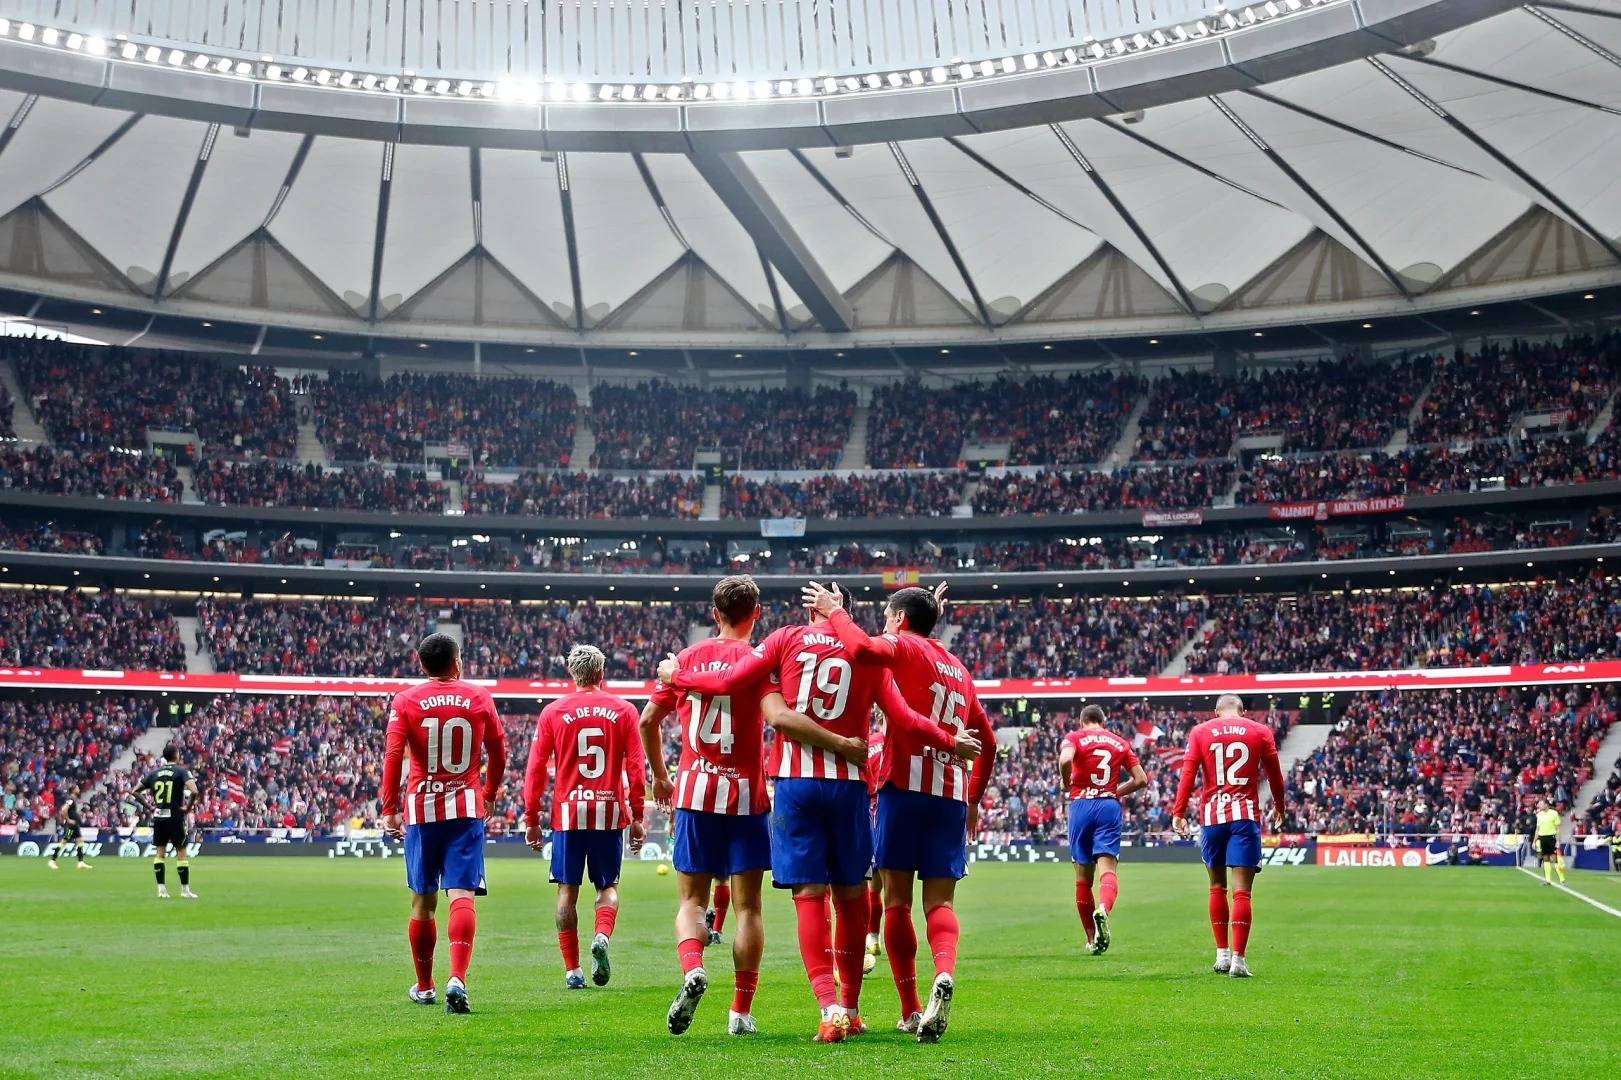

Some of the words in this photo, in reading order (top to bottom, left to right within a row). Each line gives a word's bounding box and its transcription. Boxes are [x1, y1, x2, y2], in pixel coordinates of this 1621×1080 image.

[803, 633, 846, 649] MORA
[795, 652, 852, 720] 19
[419, 694, 472, 710] CORREA
[928, 681, 967, 732] 15
[562, 713, 576, 725] R.
[576, 706, 591, 719] DE
[592, 706, 620, 724] PAUL
[685, 690, 735, 754] 14
[1211, 728, 1223, 737] S.
[1223, 726, 1247, 736] LINO
[420, 717, 472, 774] 10
[577, 727, 605, 779] 5
[1090, 748, 1112, 786] 3
[1209, 741, 1250, 786] 12
[154, 780, 174, 804] 21
[417, 775, 444, 793] ria
[569, 784, 595, 801] ria
[1324, 848, 1397, 867] LALIGA
